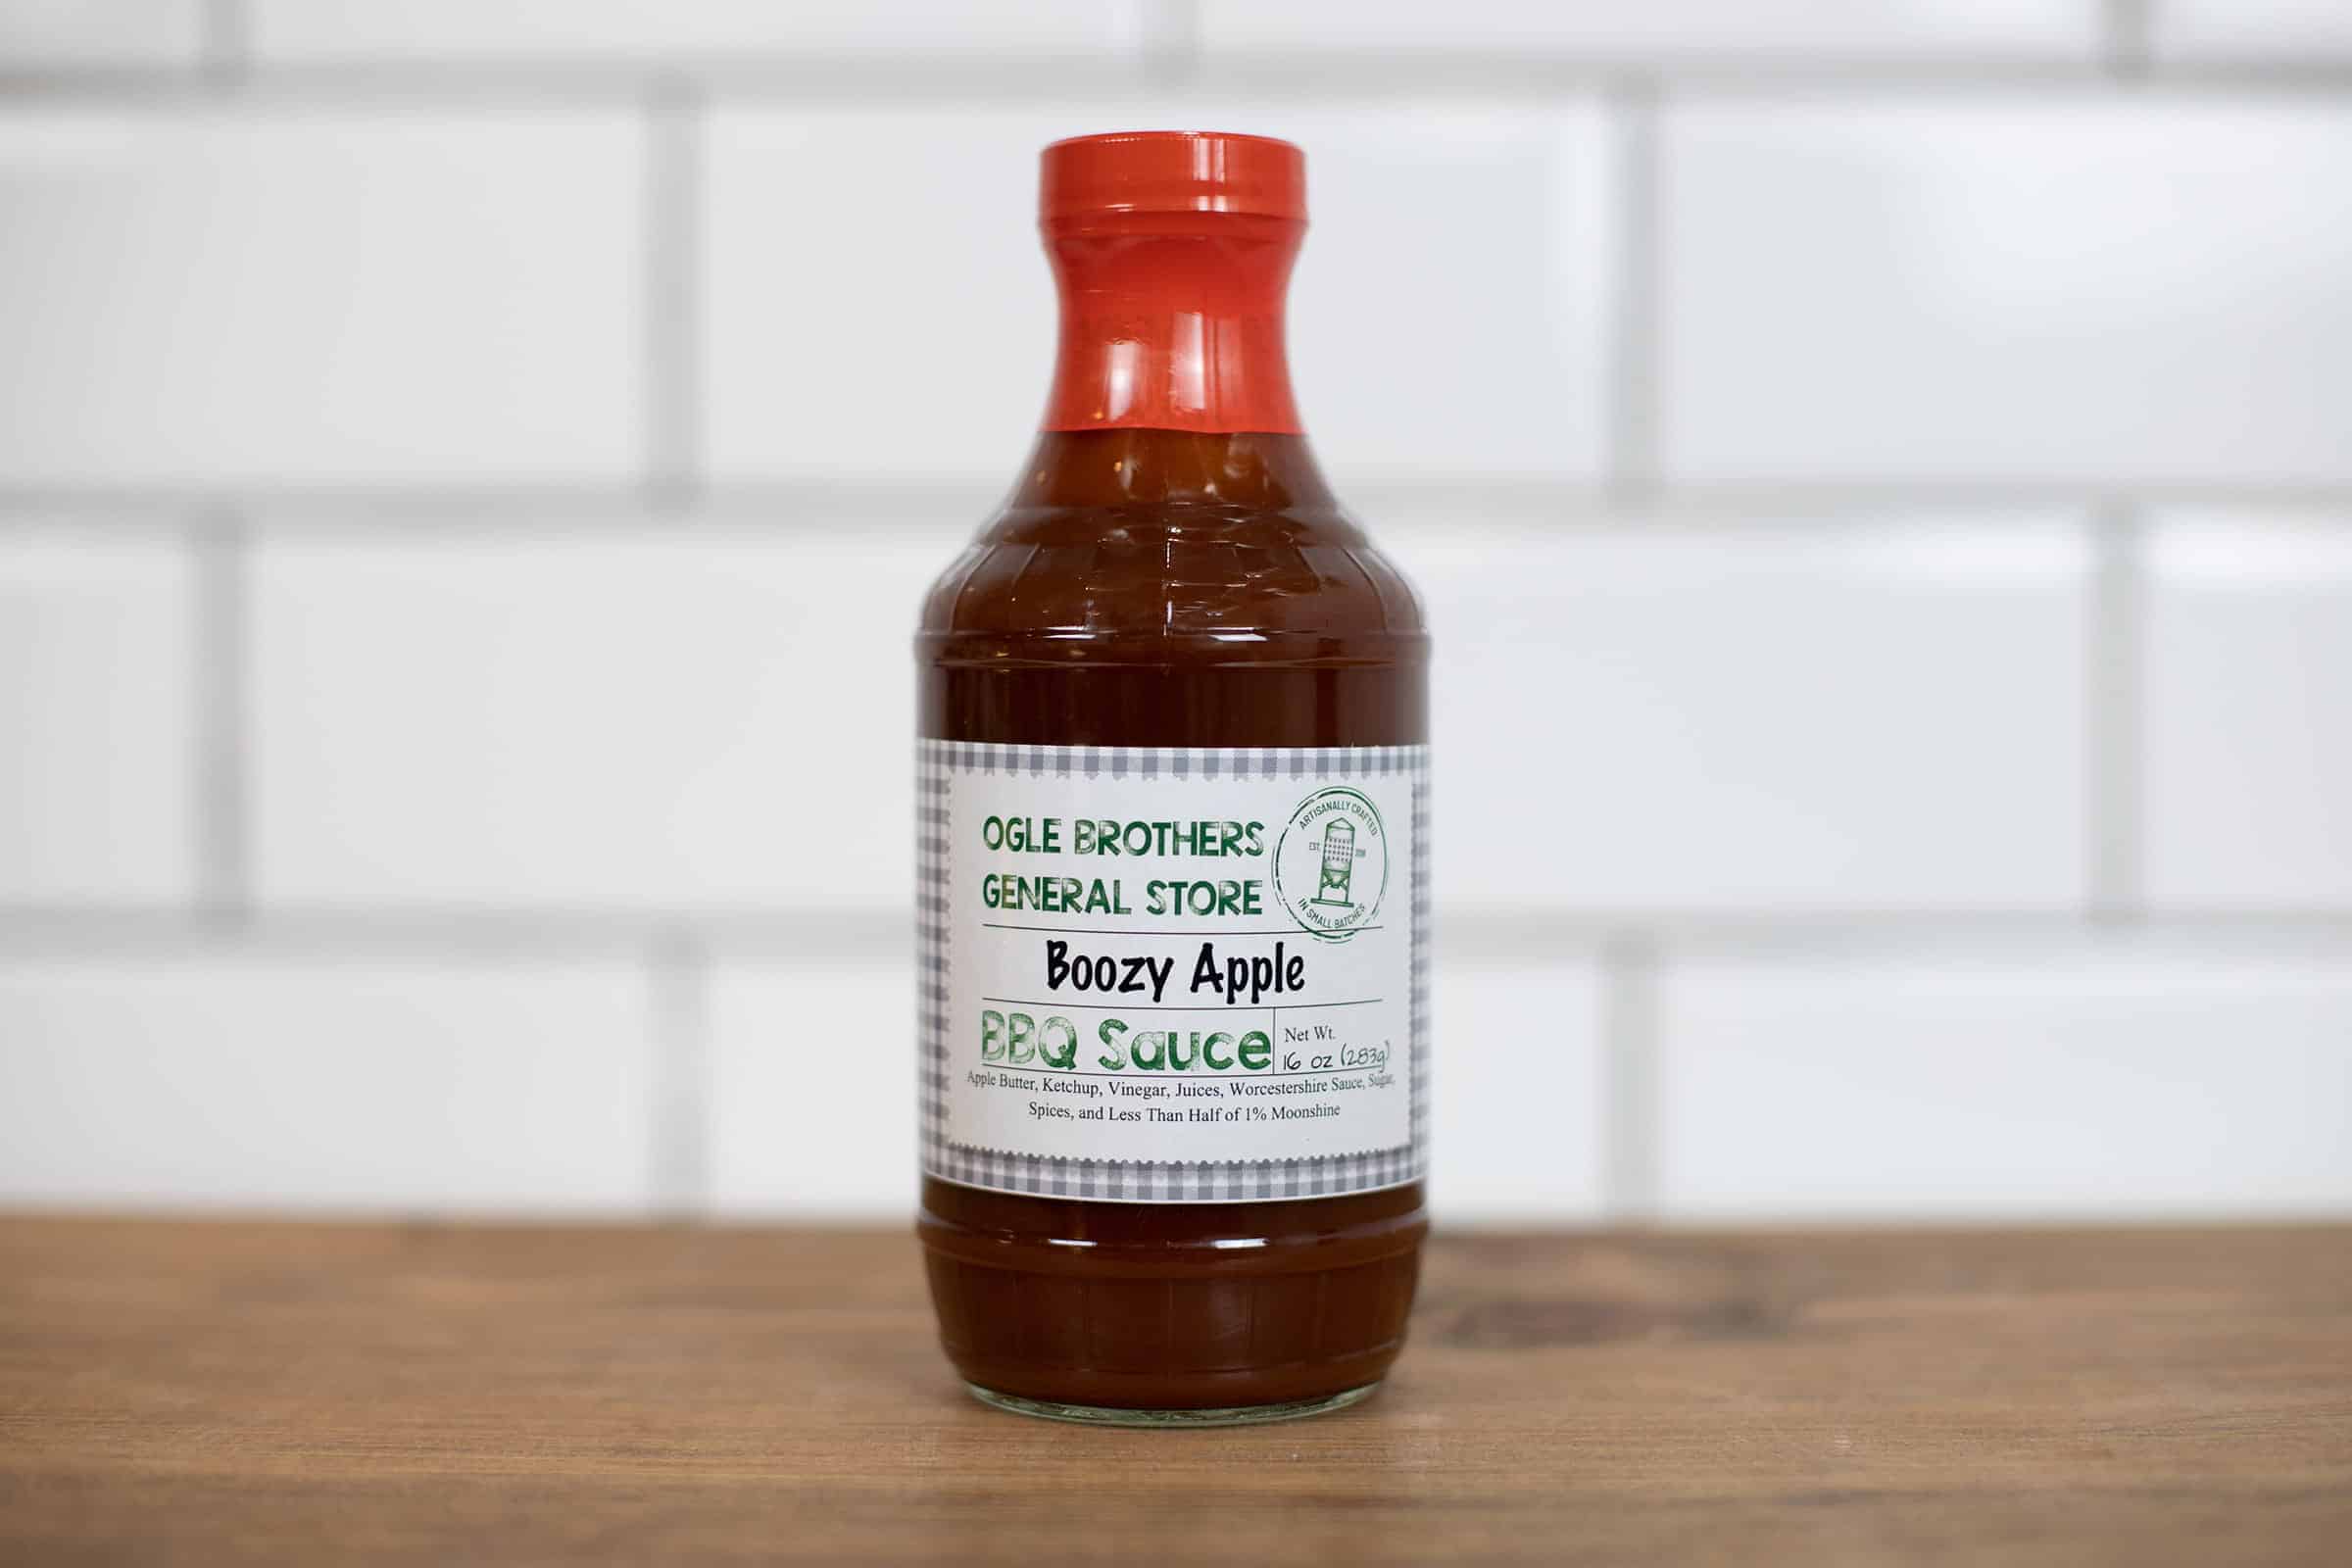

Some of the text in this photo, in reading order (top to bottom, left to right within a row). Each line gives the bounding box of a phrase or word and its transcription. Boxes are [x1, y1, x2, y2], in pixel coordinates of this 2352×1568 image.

[983, 815, 1265, 857] OGLE BROTHERS
[983, 873, 1263, 915] GENERAL STORE
[1298, 897, 1308, 911] IN
[1306, 908, 1332, 929] SMALL
[1046, 940, 1305, 1004] Boozy Apple
[982, 1009, 1271, 1071] BBQ Sauce
[1285, 1025, 1336, 1043] Net Wt.
[1284, 1039, 1390, 1074] 16 oz (283g)
[967, 1069, 997, 1088] Apple
[1000, 1073, 1038, 1092] Butter,
[1042, 1077, 1103, 1099] Ketchup,
[1108, 1081, 1170, 1100] Vinegar,
[1175, 1082, 1224, 1099] Juices,
[1229, 1079, 1328, 1097] Worcestershire
[1332, 1076, 1365, 1091] Sauce,
[1029, 1101, 1341, 1122] Spices, and Less Than Half of 1% Moonshine
